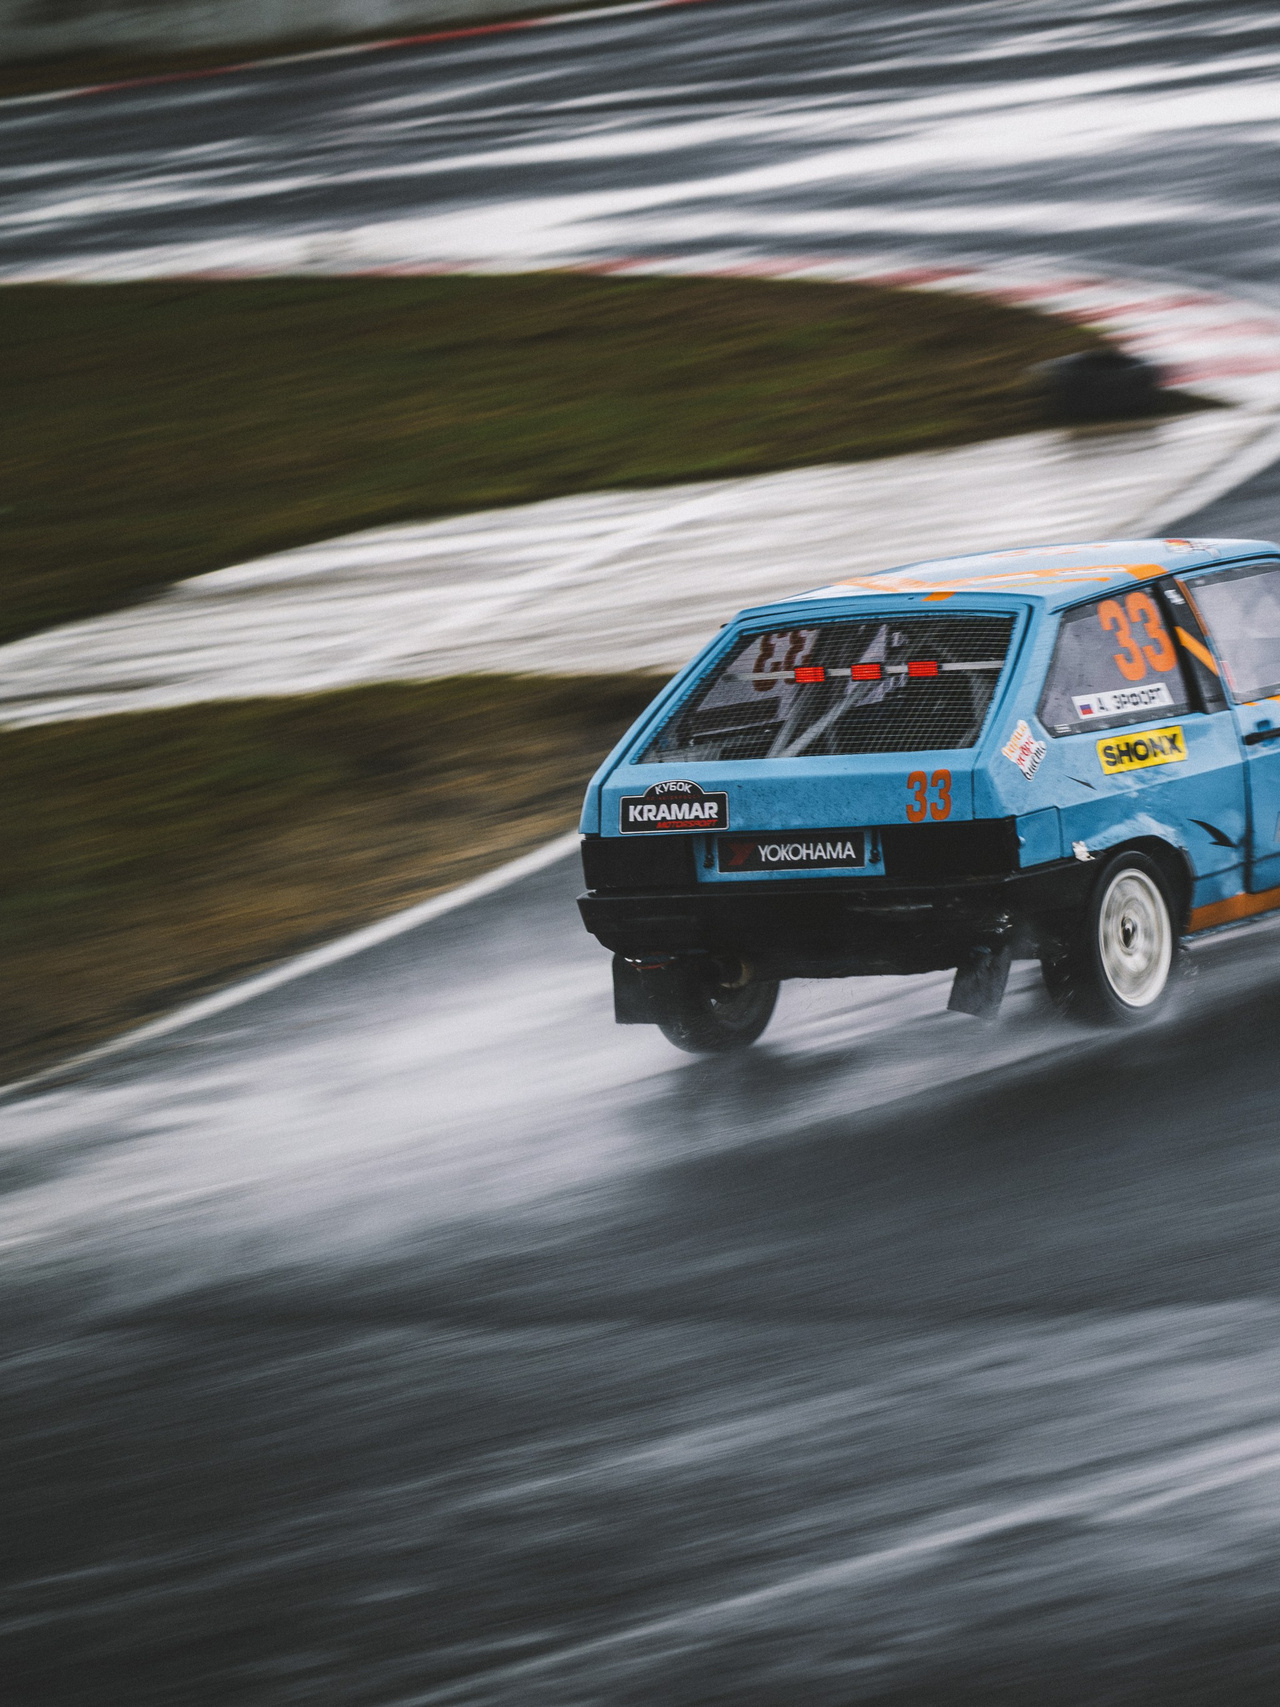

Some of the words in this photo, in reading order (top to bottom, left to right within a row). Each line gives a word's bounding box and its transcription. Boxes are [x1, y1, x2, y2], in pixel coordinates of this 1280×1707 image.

[1097, 592, 1177, 681] 33
[1102, 733, 1183, 767] SHONX
[654, 781, 693, 795] КУБОК
[906, 769, 952, 823] 33
[628, 802, 719, 822] KRAMAR
[656, 819, 718, 829] MOTORSPORT
[757, 841, 857, 862] YOKOHAMA
